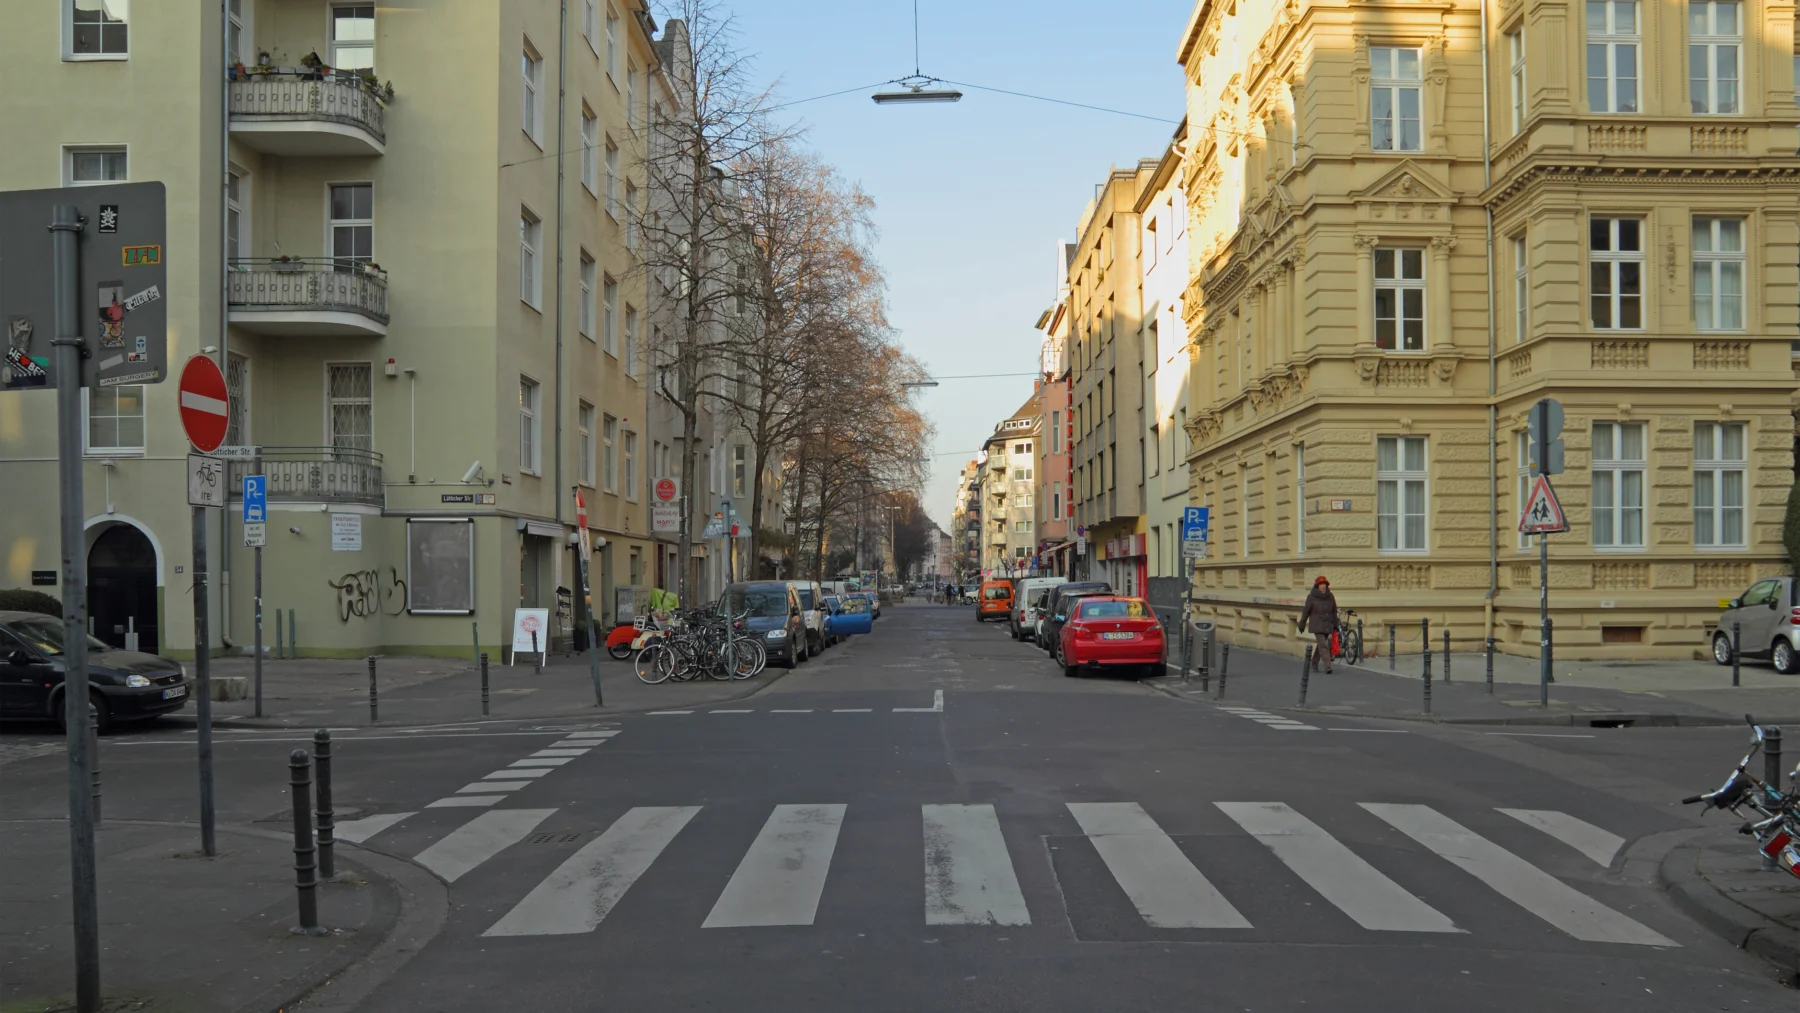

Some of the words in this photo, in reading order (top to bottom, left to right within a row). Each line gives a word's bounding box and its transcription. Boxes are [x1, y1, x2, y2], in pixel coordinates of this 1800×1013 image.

[8, 347, 22, 361] WE
[102, 377, 118, 385] JAM
[119, 371, 156, 381] SURGERY
[240, 447, 252, 456] Str.
